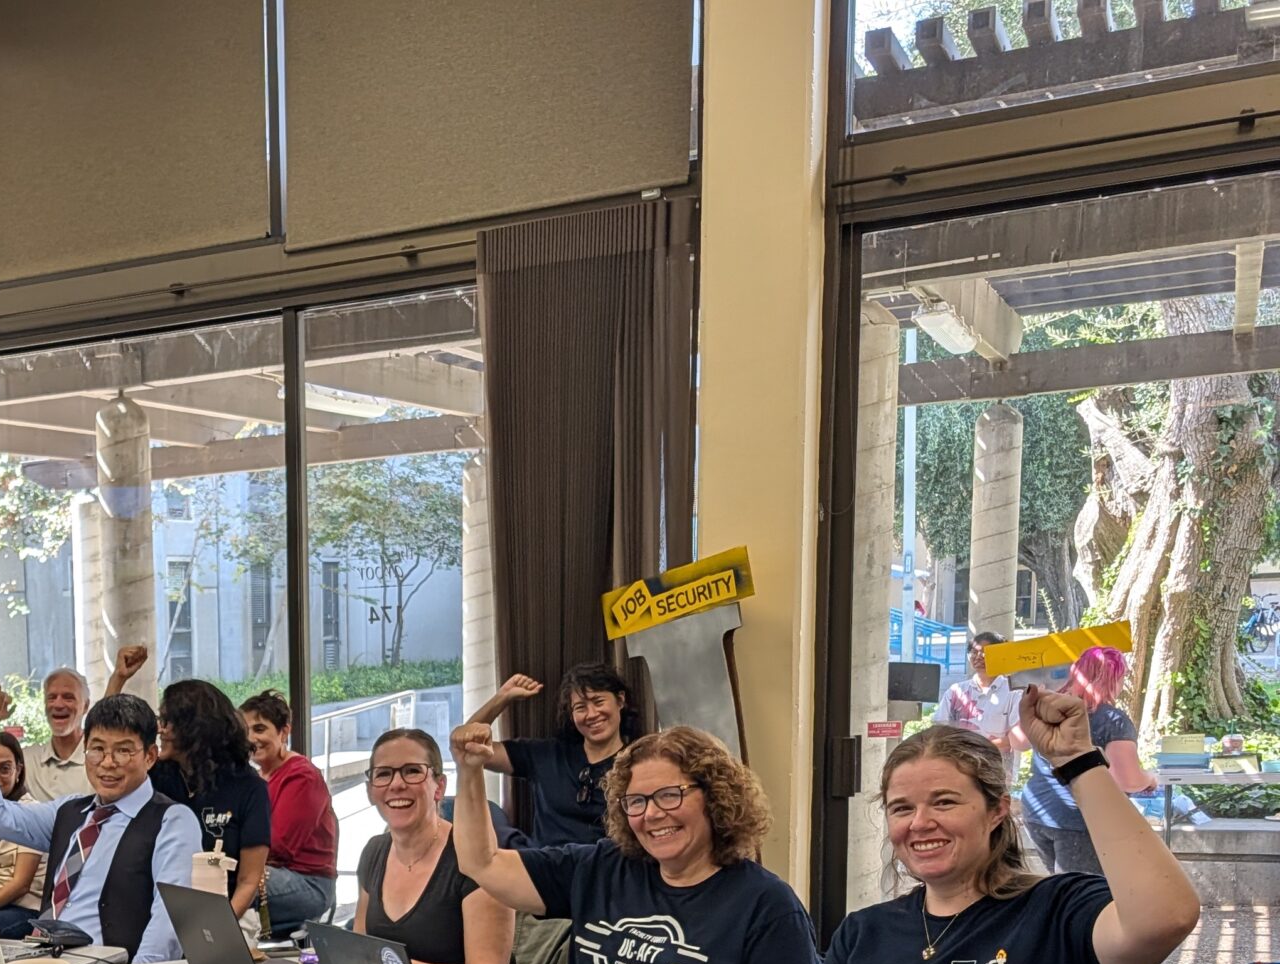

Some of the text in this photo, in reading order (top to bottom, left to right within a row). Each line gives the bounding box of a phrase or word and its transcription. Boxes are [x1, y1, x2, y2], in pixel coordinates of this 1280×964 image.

[620, 575, 732, 621] JOB SECURITY
[205, 812, 231, 825] UC-AFT
[617, 938, 664, 964] UC-AFT
